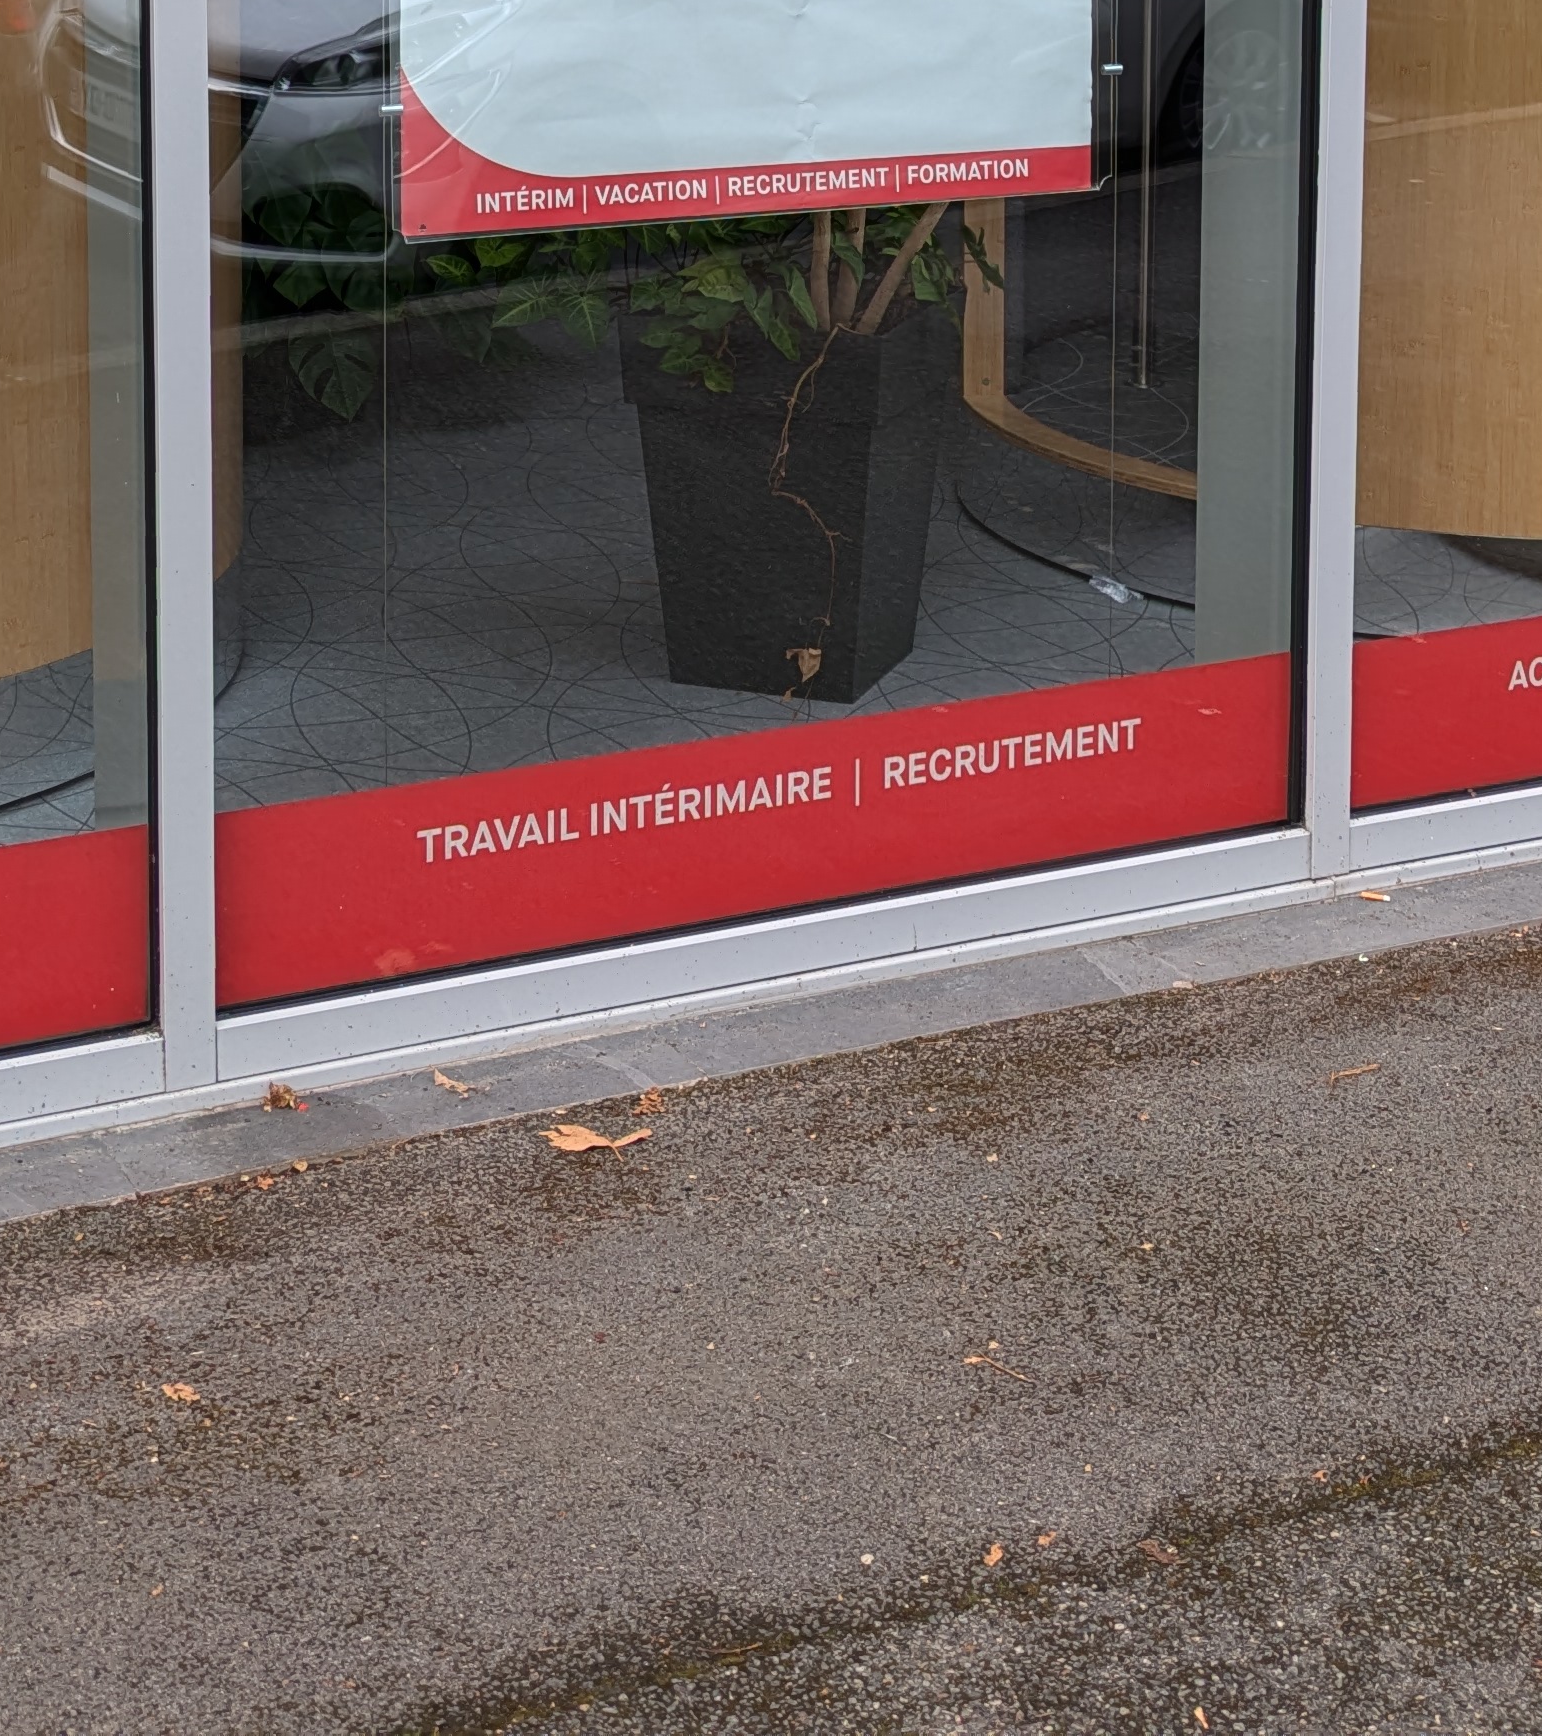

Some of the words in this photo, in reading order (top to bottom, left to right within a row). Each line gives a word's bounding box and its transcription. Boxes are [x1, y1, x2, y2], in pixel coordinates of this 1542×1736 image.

[476, 187, 575, 214] INTÉRIM
[595, 178, 707, 207] VACATION
[727, 167, 890, 197] RECRUTEMENT
[907, 158, 1030, 183] FORMATION
[417, 809, 578, 863] TRAVAIL
[589, 766, 832, 836] INTÉRIMAIRE
[883, 718, 1141, 789] RECRUTEMENT
